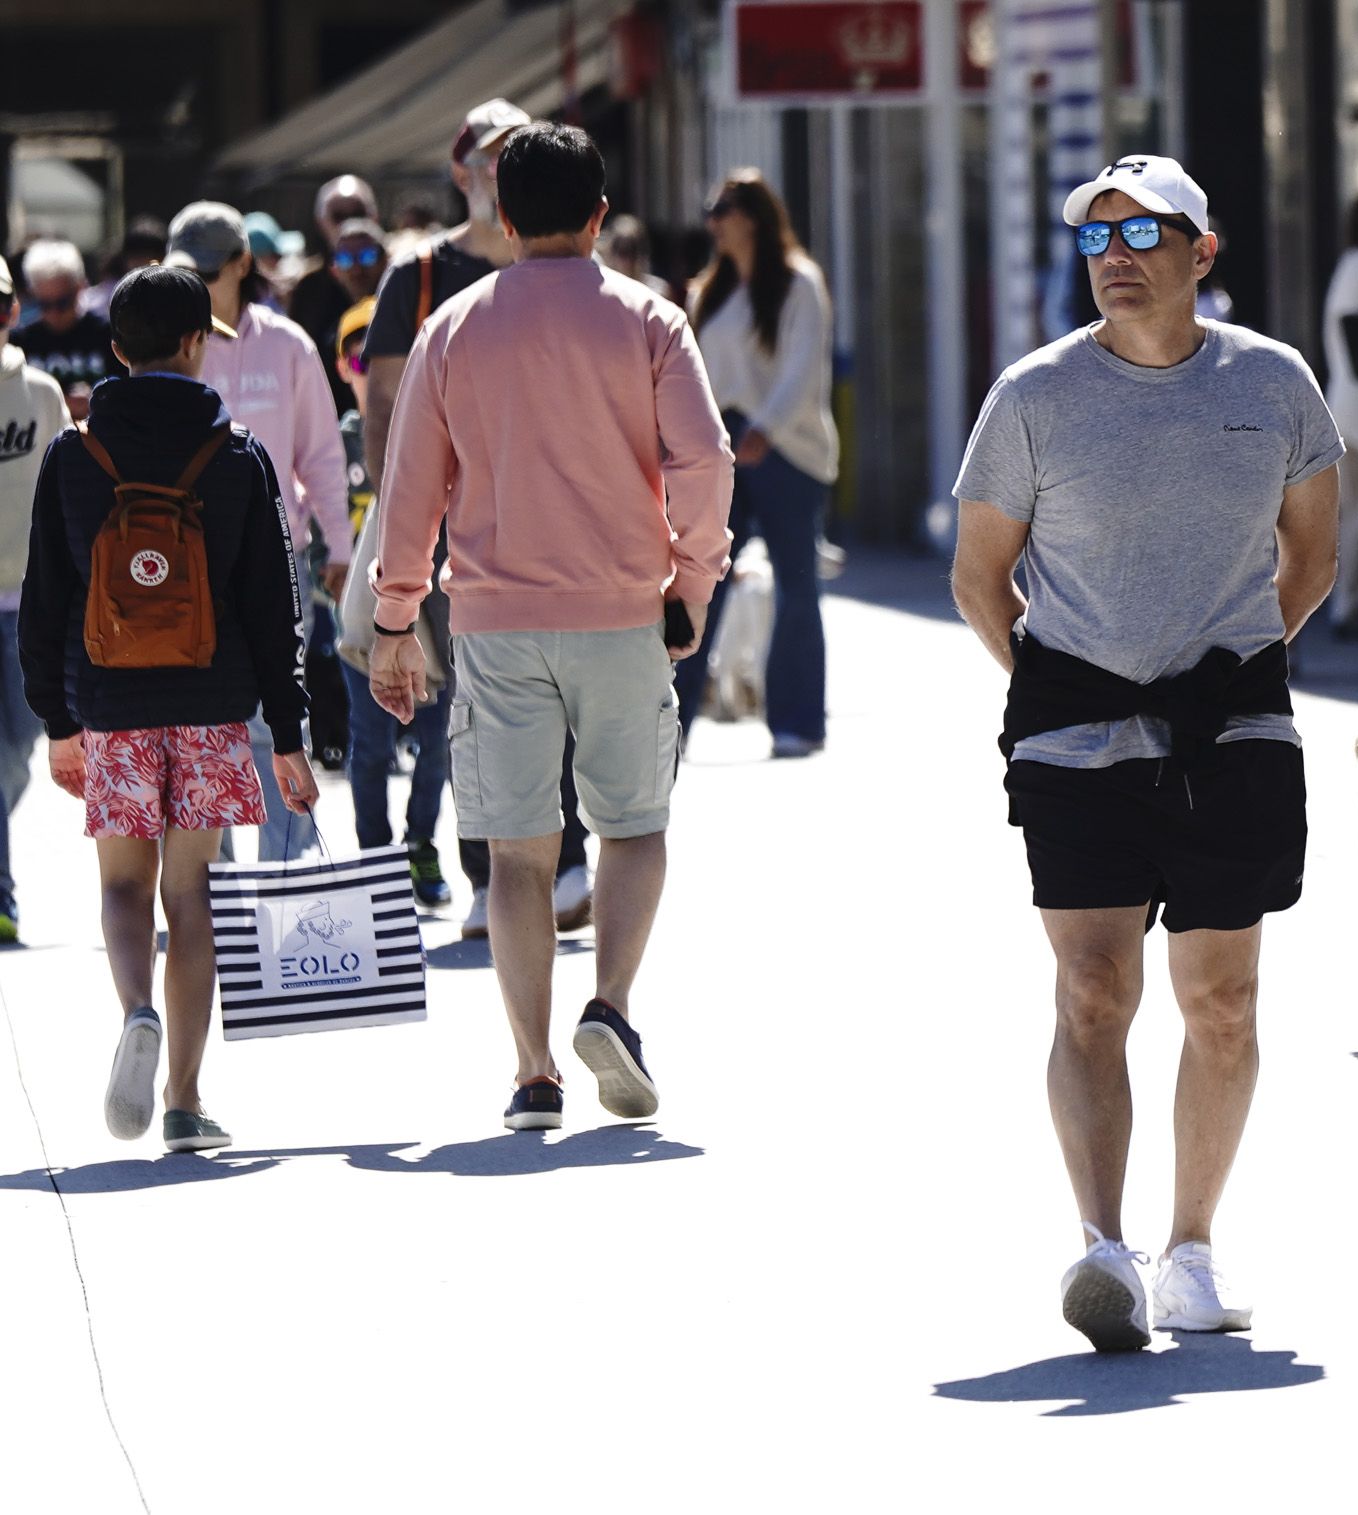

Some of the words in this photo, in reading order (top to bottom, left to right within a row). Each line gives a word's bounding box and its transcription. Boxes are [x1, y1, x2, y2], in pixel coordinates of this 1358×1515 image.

[274, 495, 290, 538] AMERICA
[284, 537, 293, 551] OF
[287, 552, 297, 583] STATES
[292, 585, 300, 618] UNITED
[280, 952, 360, 978] EOLO
